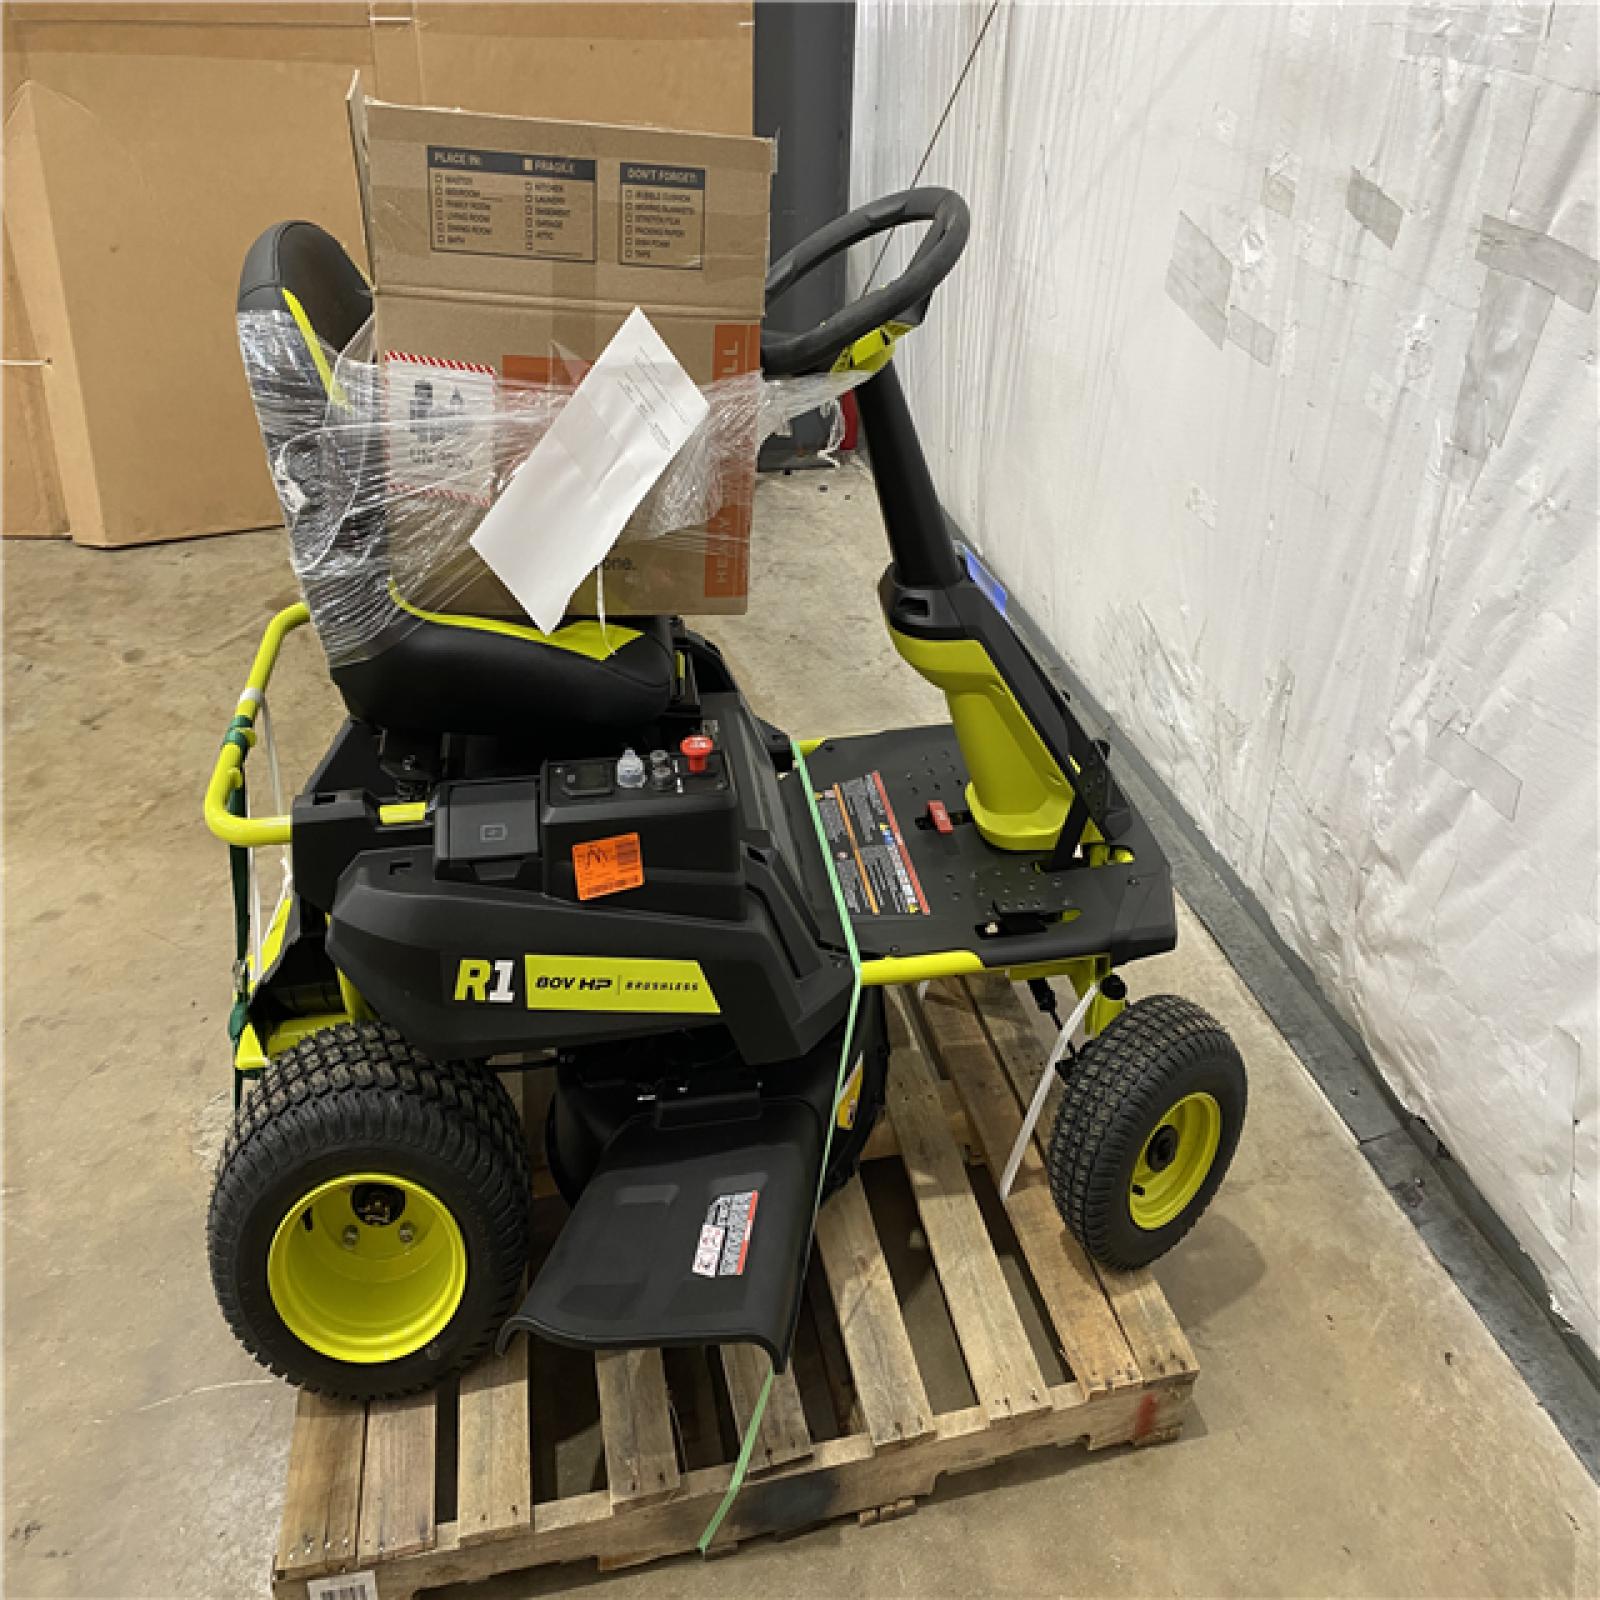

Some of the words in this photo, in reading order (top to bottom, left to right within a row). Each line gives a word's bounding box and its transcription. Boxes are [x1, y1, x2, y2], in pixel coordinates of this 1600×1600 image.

[434, 151, 466, 166] PLACE
[534, 160, 576, 174] FRAGILE
[534, 183, 564, 193] KITCHEN
[470, 201, 492, 211] ROOM
[470, 213, 491, 223] ROOM
[471, 226, 492, 235] ROOM
[454, 959, 516, 1003] R1
[535, 975, 576, 990] 80V
[579, 977, 613, 991] HP
[625, 981, 699, 991] BRUSHLESS
